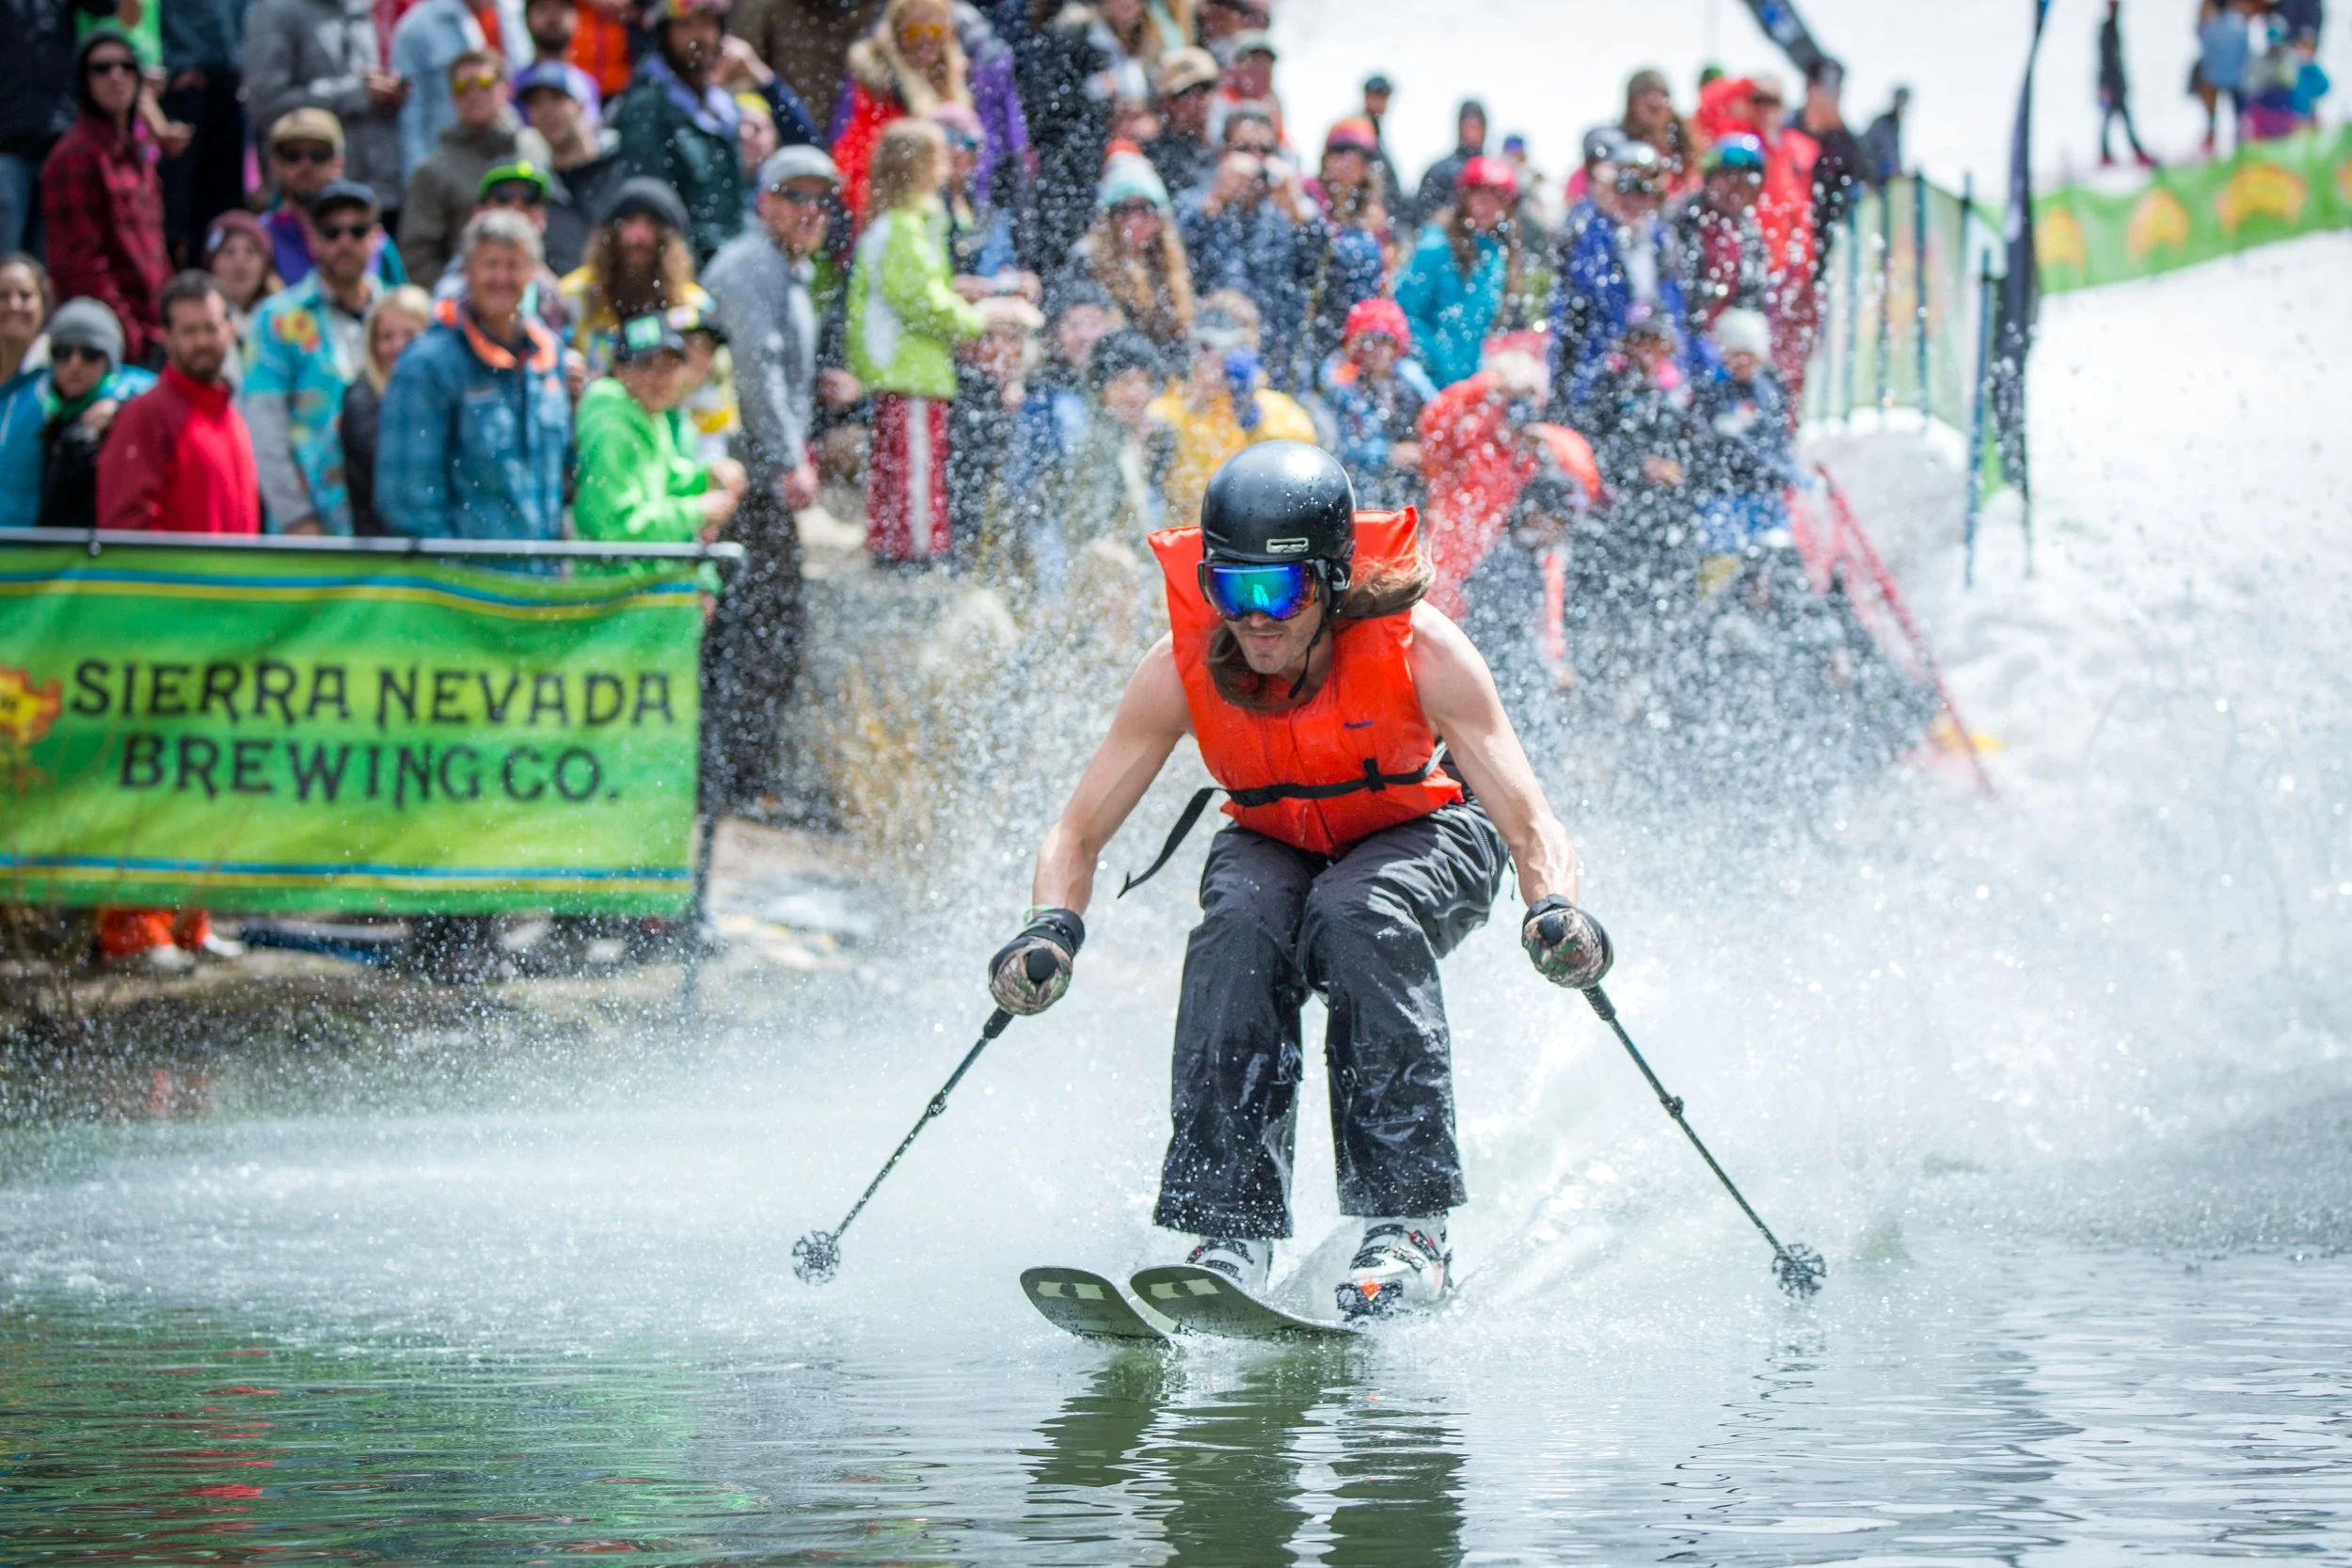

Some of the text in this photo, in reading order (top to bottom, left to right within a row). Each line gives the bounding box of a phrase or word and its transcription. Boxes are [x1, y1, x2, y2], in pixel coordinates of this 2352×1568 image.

[72, 658, 675, 731] SIERRA NEVADA
[118, 733, 621, 810] BREWING CO.
